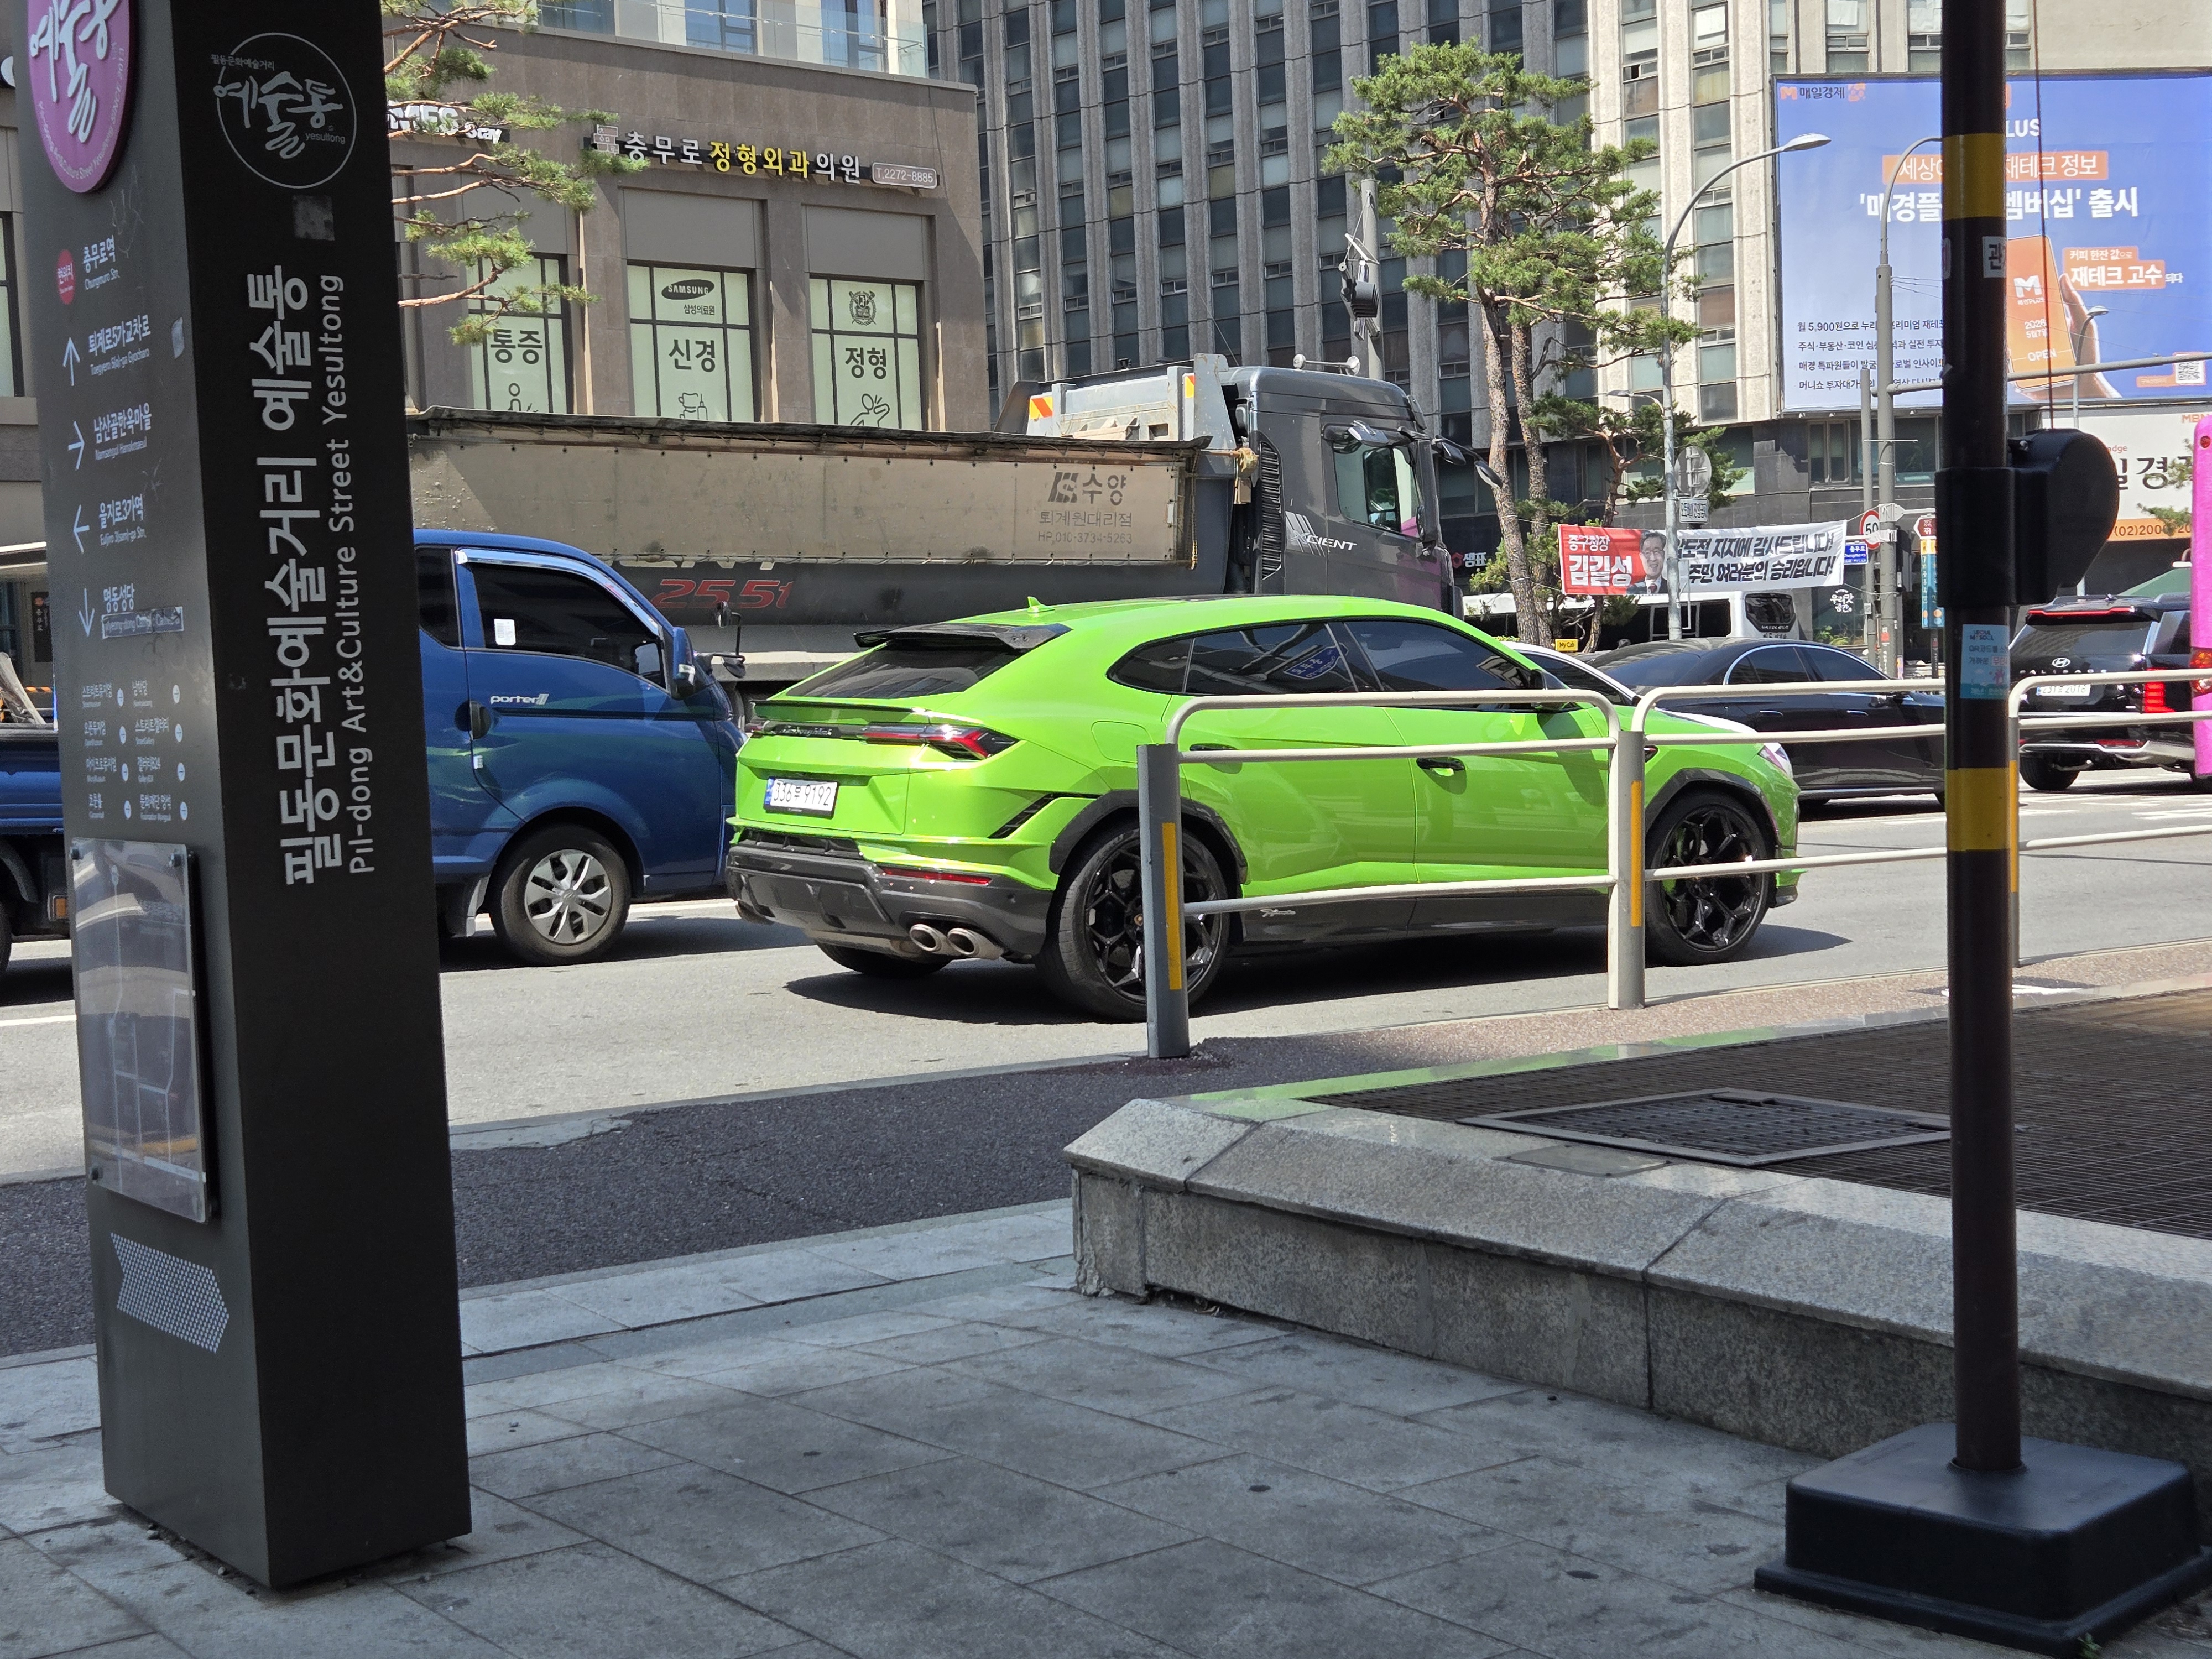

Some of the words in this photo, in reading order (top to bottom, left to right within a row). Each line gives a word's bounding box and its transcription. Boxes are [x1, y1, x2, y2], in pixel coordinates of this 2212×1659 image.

[211, 54, 275, 71] 필동문화예술거리
[1799, 86, 1845, 100] 매일경제
[213, 71, 343, 159] 예술통
[305, 132, 346, 144] yesultong
[2006, 118, 2040, 137] LUS
[875, 168, 933, 183] T.2272-8885
[2060, 154, 2099, 178] 정보
[2088, 187, 2139, 218] 출시
[83, 234, 116, 273] 충무로역
[2070, 249, 2089, 261] 커피
[2090, 249, 2109, 260] 한잔
[2110, 249, 2133, 260] 값으로
[2070, 265, 2124, 287] 재테크
[2127, 264, 2163, 285] 고수
[667, 284, 711, 295] SAMSUNG
[683, 304, 716, 316] 삼성의료원
[88, 314, 151, 356] 퇴계로5가교차로
[1798, 322, 1806, 332] 월
[1808, 321, 1859, 332] 5,900원으로
[1893, 320, 1920, 330] 리미엄
[247, 265, 312, 431] 예술통
[317, 275, 347, 425] Yesultong
[490, 329, 544, 365] 통증
[669, 338, 717, 373] 신경
[1908, 339, 1924, 349] 실전
[2027, 348, 2057, 362] OPEN
[845, 347, 887, 379] 정형
[1799, 361, 1815, 371] 매경
[1818, 360, 1859, 371] 특파원들이
[1799, 380, 1824, 390] 머니쇼
[93, 402, 152, 444] 남산골한옥마을
[326, 439, 354, 532] Street
[1082, 473, 1127, 506] 수양
[98, 493, 144, 529] 을지로3가역
[1039, 510, 1132, 528] 퇴계원대리점
[1290, 530, 1358, 551] XCIENT
[1866, 523, 1879, 534] 50
[1568, 534, 1610, 552] 중구청장
[1712, 536, 1754, 559] 지지에
[1754, 532, 1834, 557] 감사드립니다!
[1463, 552, 1487, 568] 샘표
[1569, 555, 1632, 586] 김길성
[1689, 562, 1715, 584] 주민
[1716, 561, 1769, 583] 여러분의
[1770, 556, 1837, 581] 승리입니다!
[103, 582, 135, 613] 명동성당
[335, 546, 367, 733] Art&Culture
[256, 457, 342, 884] 필동문화예술거리
[773, 782, 801, 802] 336무
[804, 784, 832, 806] 9192
[346, 748, 375, 873] Pil-dong
